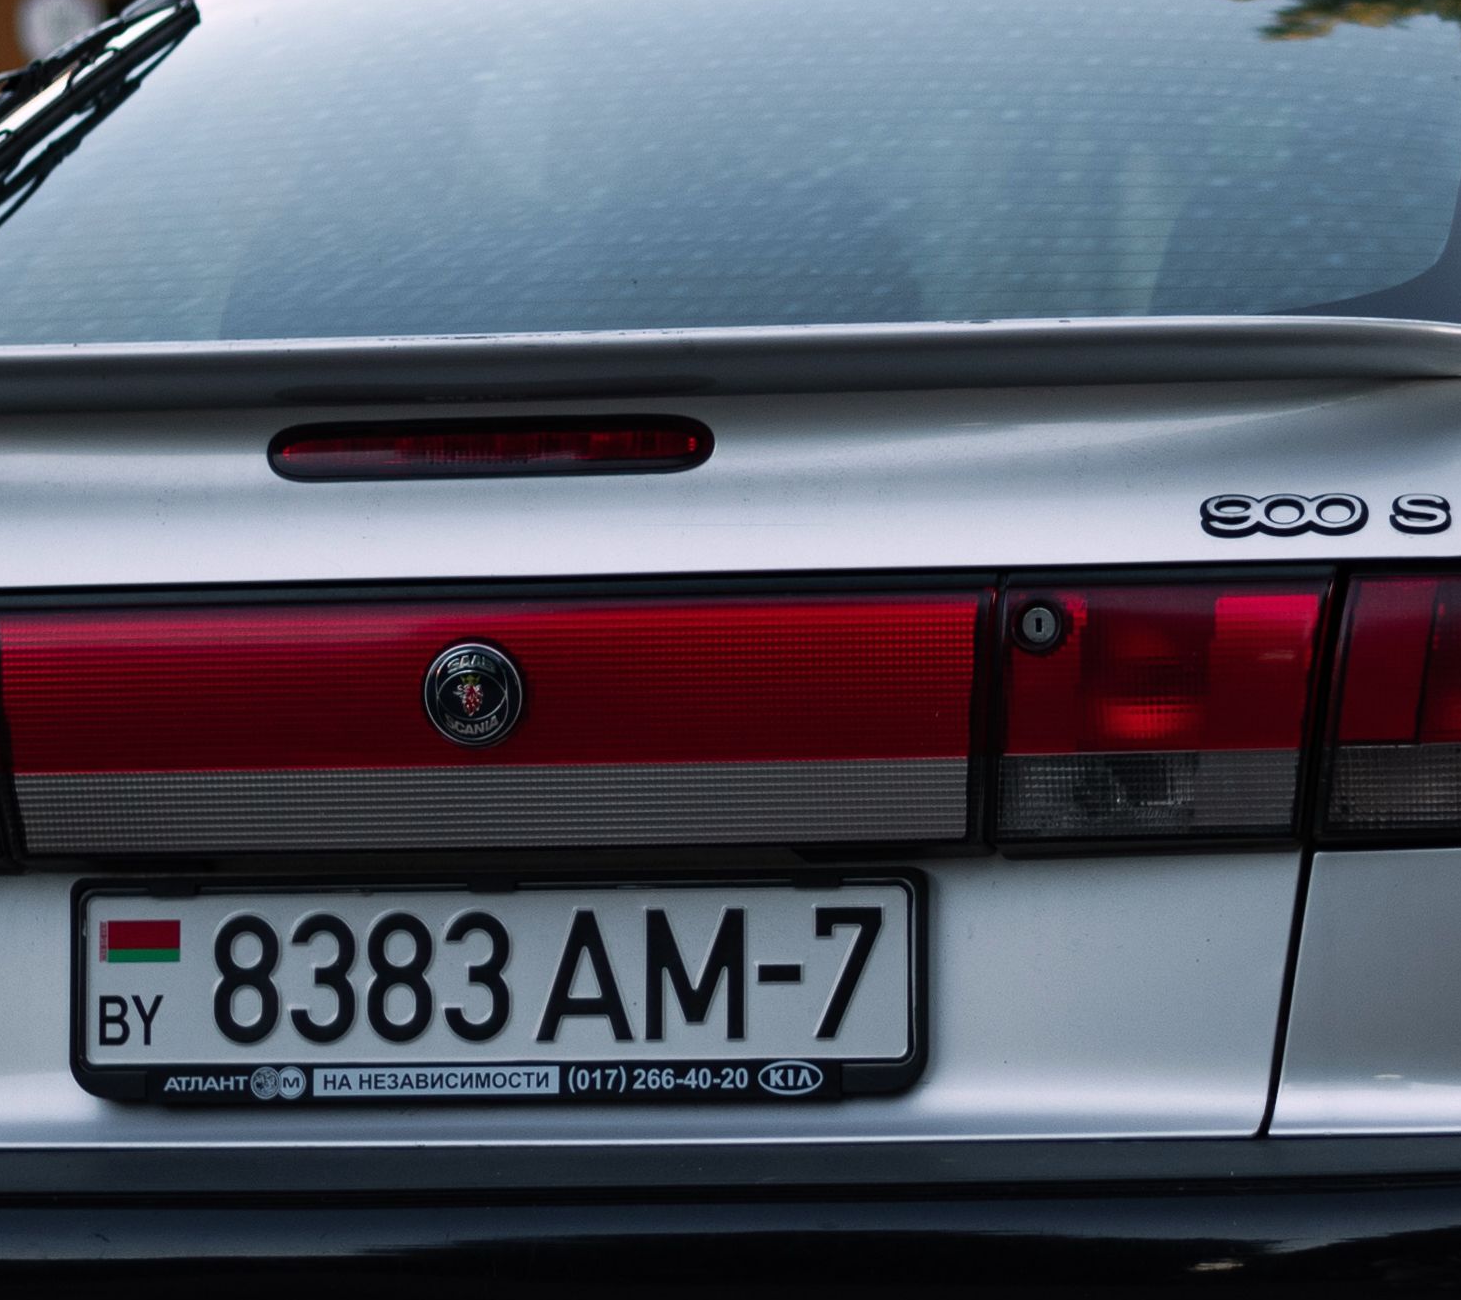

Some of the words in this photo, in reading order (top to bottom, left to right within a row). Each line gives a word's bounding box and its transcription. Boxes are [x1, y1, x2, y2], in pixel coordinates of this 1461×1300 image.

[1200, 494, 1369, 538] 900
[1389, 494, 1452, 535] S
[213, 912, 511, 1044] 8383
[537, 906, 883, 1041] AM-7
[98, 994, 164, 1046] BY
[163, 1076, 248, 1092] АТЛАНТ
[323, 1073, 353, 1091] НА
[358, 1070, 550, 1090] НЕЗАВИСИМОСТИ
[568, 1066, 627, 1093] (017)
[632, 1067, 749, 1090] 266-40-20
[769, 1069, 814, 1088] KIA
